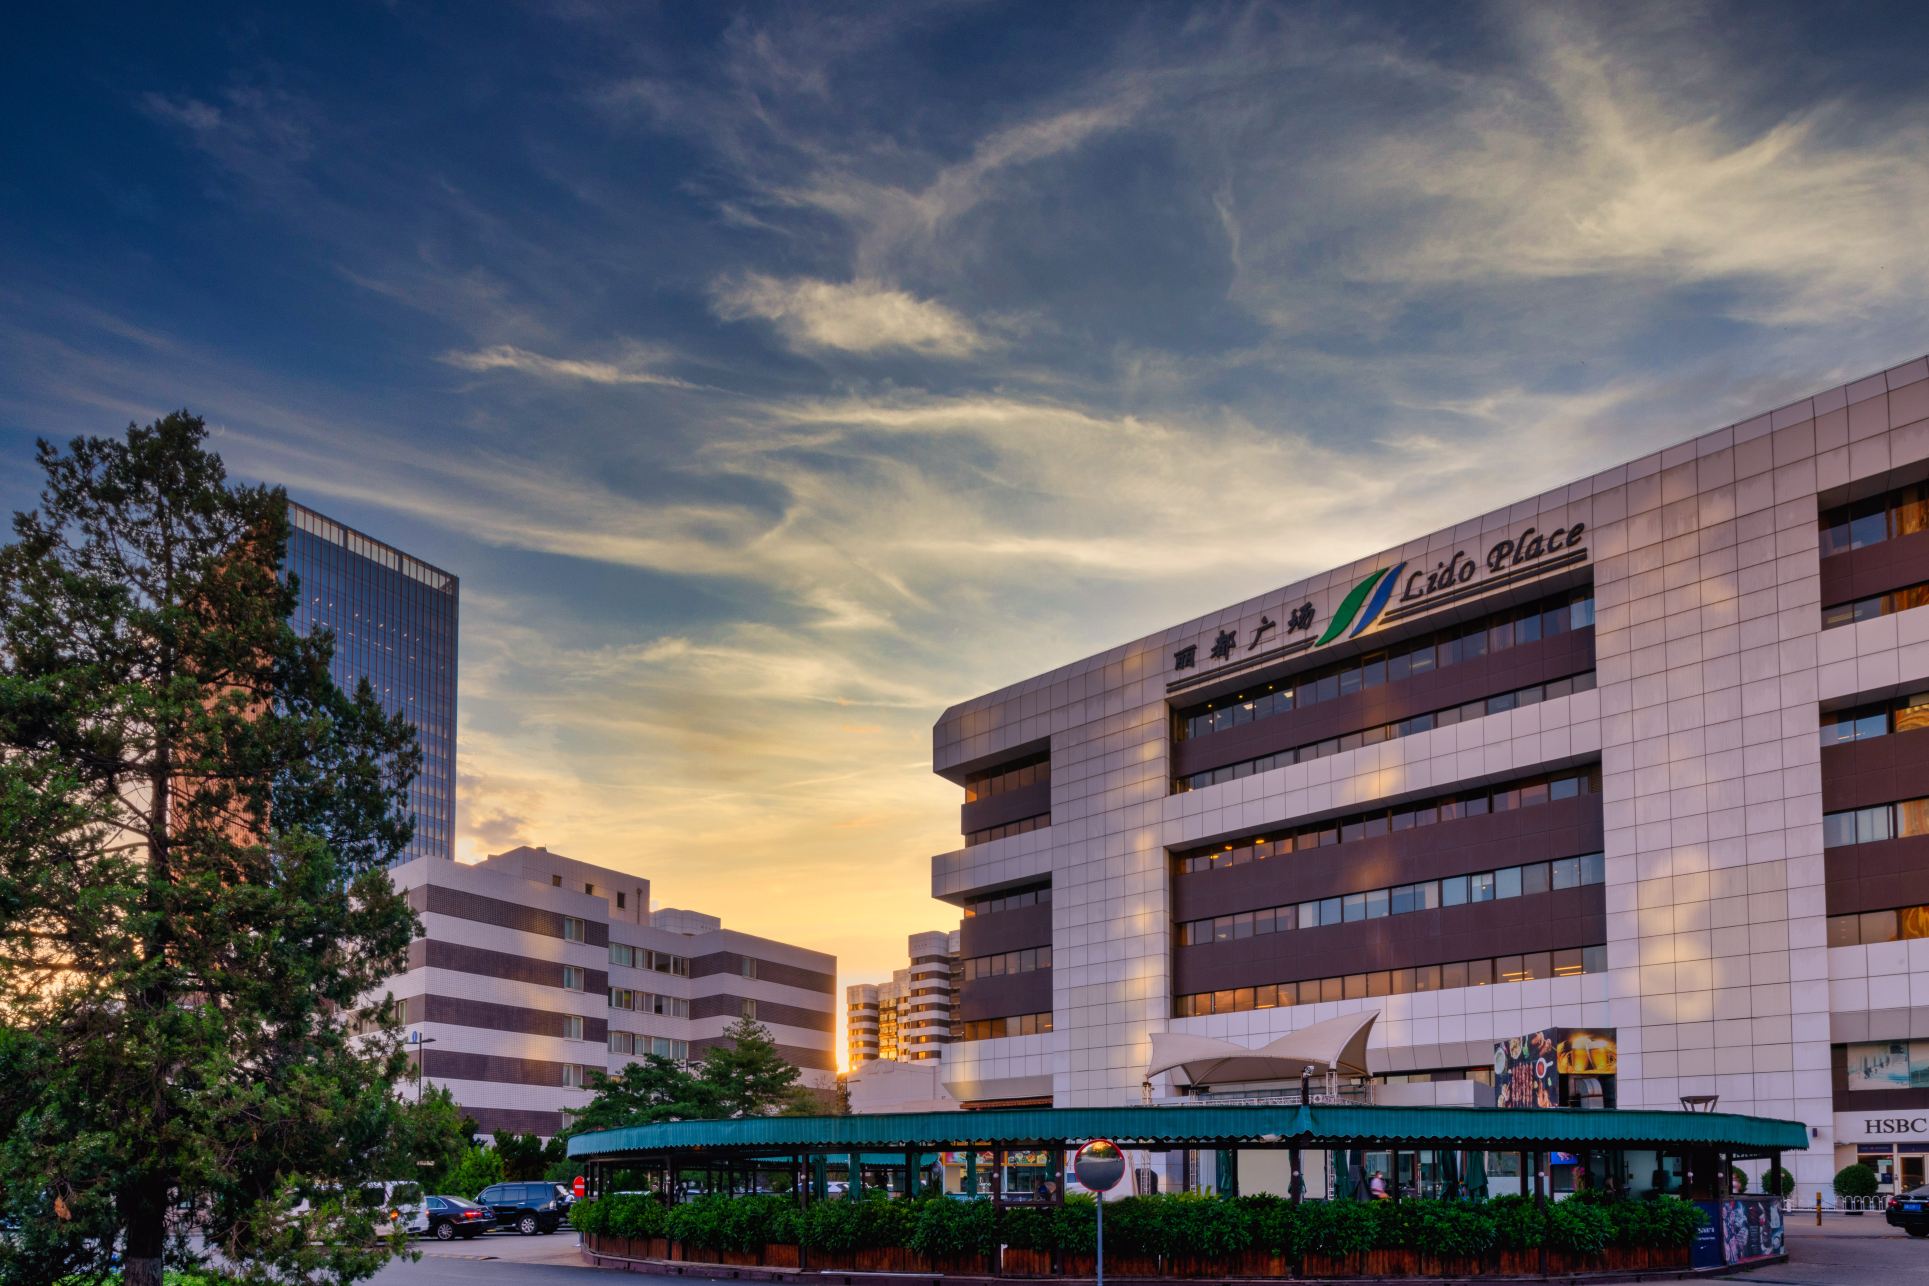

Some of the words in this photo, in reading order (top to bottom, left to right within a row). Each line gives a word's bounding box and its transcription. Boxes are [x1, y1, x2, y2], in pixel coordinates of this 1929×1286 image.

[1400, 551, 1476, 601] Lido
[1486, 522, 1585, 572] Place
[1174, 601, 1315, 671] 丽都广场
[1864, 1118, 1928, 1134] HSBC
